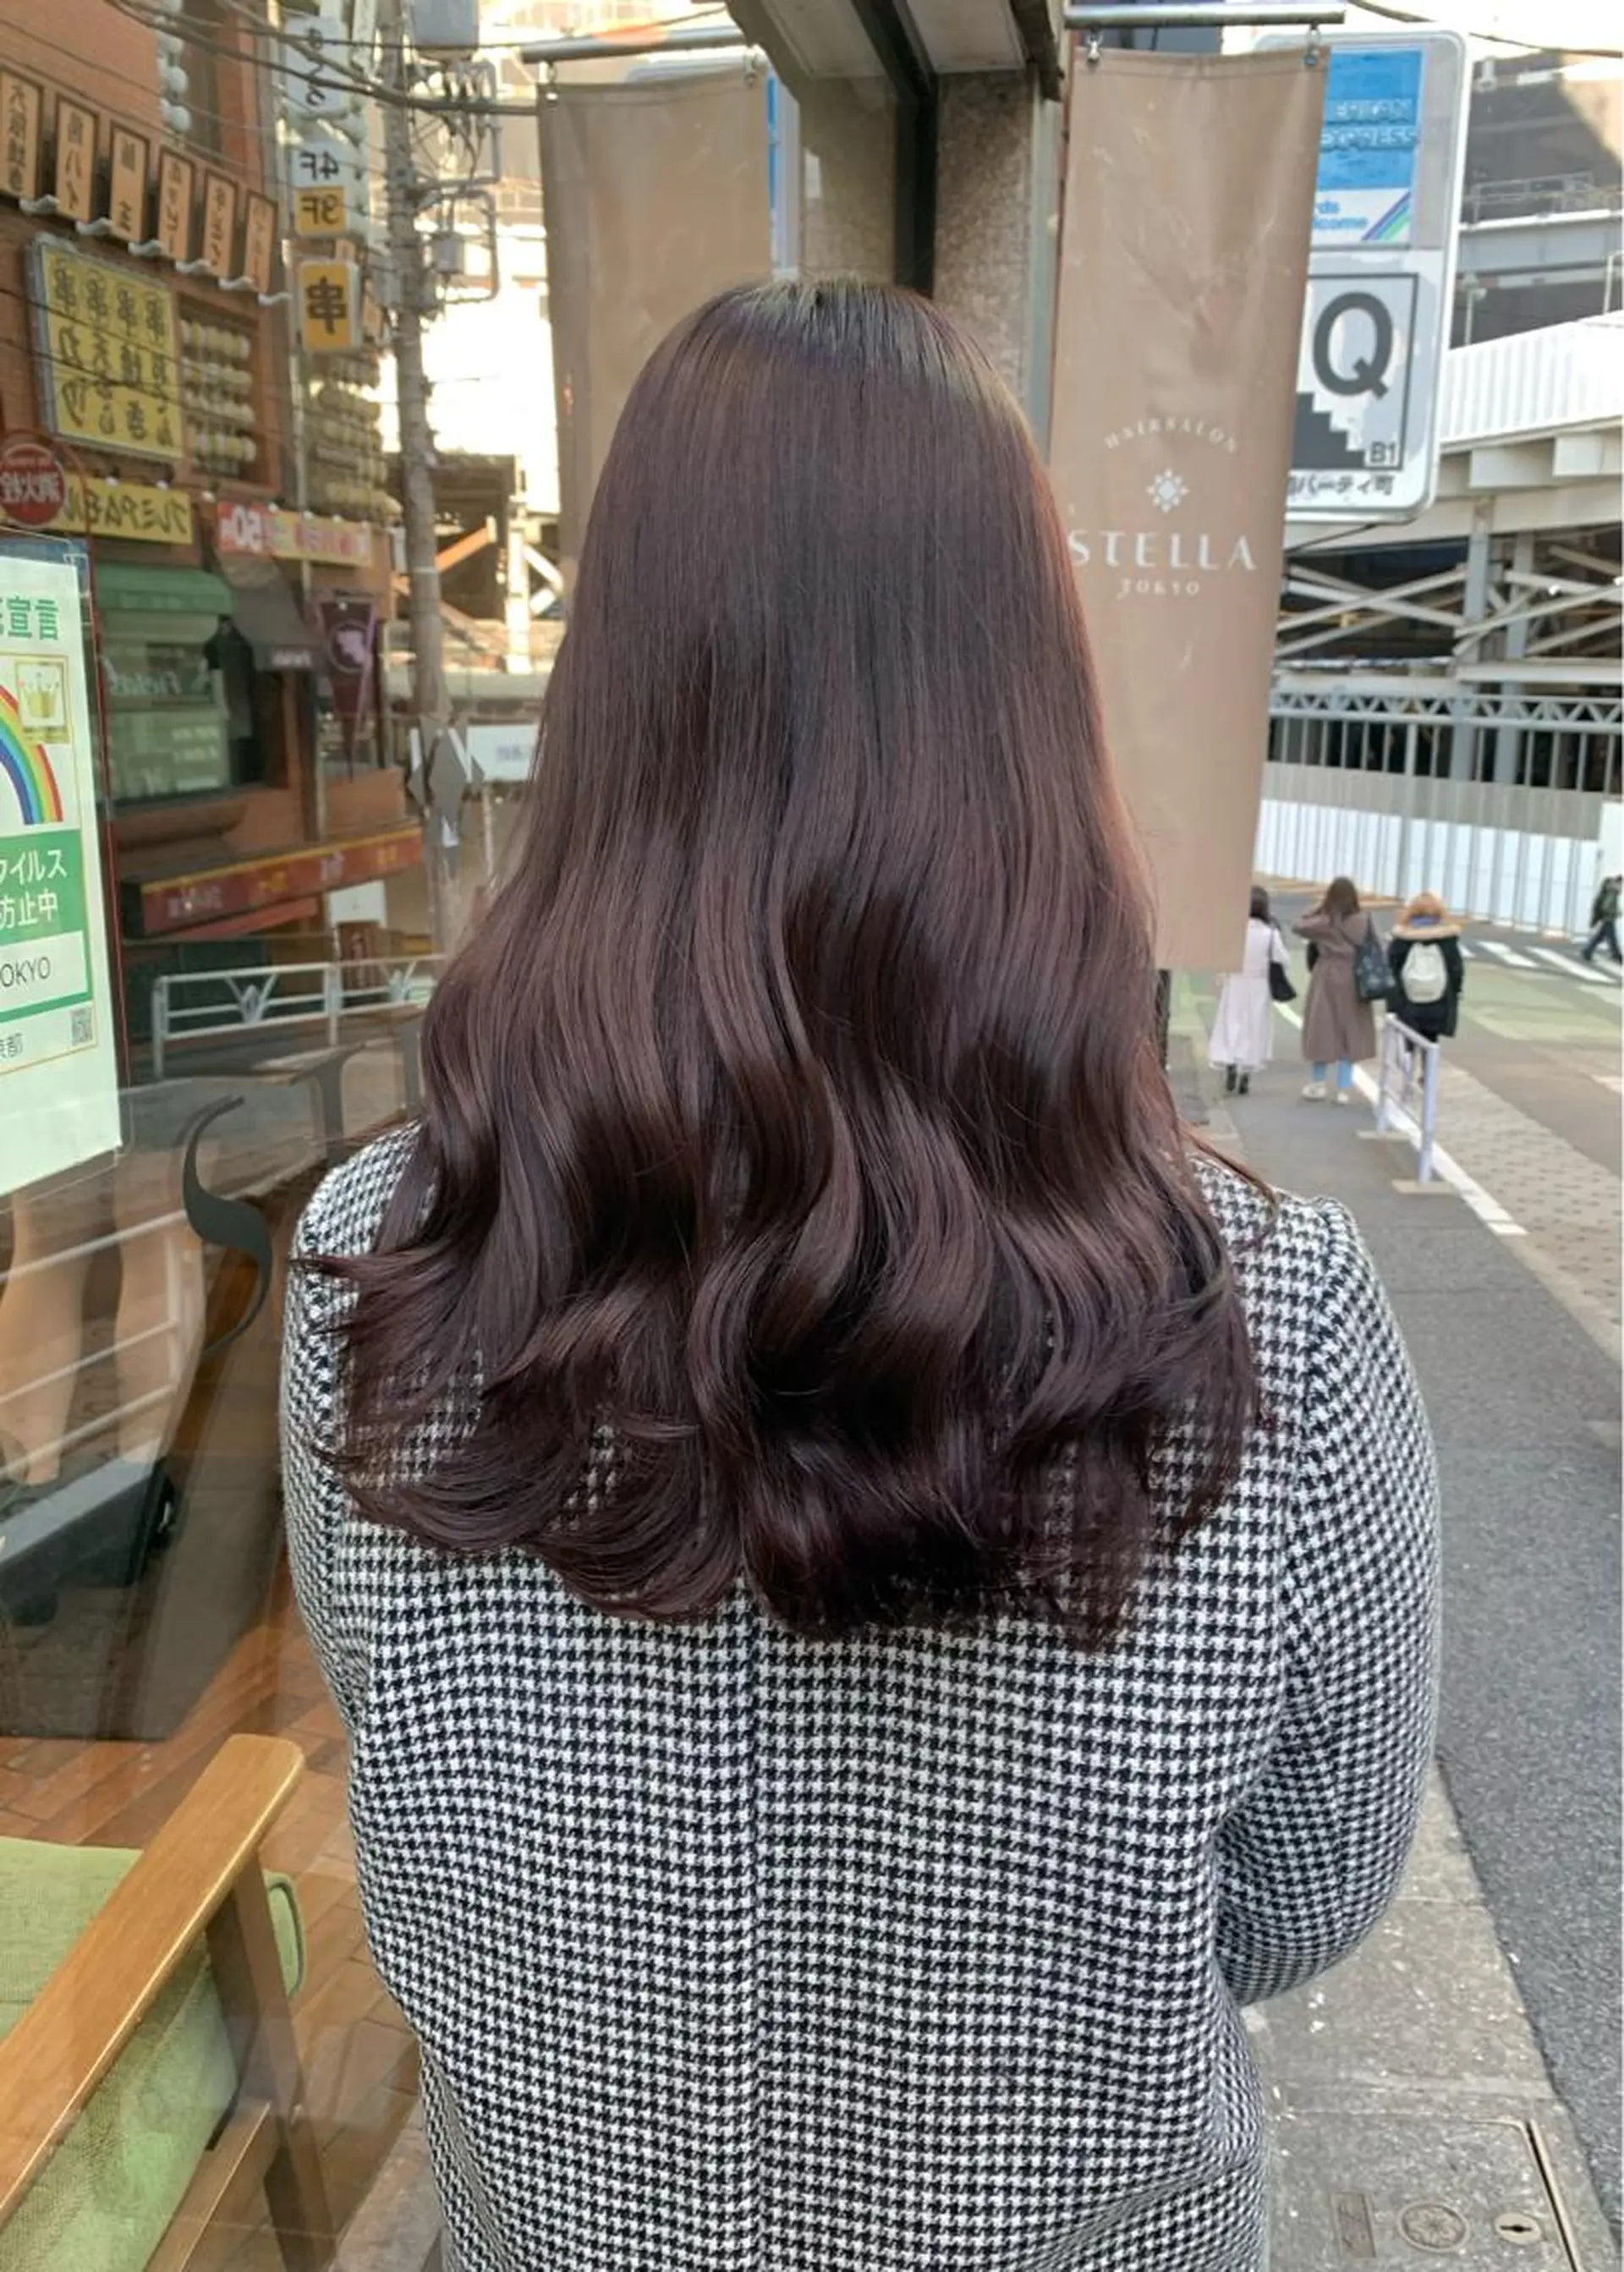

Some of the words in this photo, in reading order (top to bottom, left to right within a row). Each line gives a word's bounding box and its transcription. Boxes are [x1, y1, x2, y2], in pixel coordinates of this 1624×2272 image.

[1313, 291, 1393, 400] Q
[1369, 441, 1396, 464] B1
[1067, 529, 1258, 571] STELLA
[1116, 577, 1201, 601] TOKYO
[0, 595, 58, 640] 宣言
